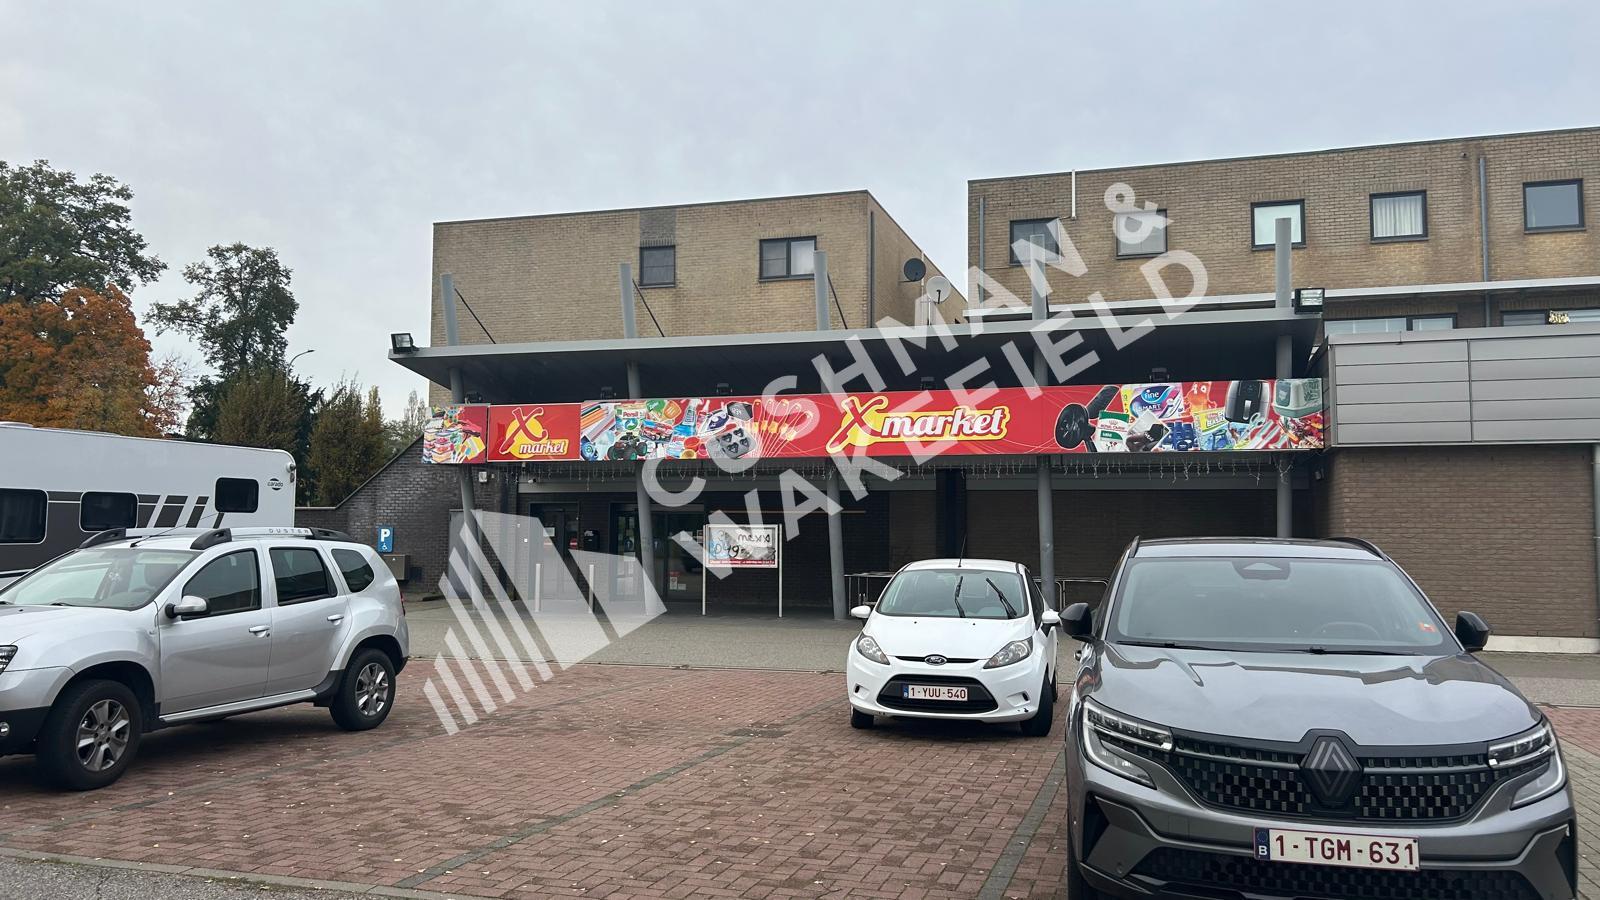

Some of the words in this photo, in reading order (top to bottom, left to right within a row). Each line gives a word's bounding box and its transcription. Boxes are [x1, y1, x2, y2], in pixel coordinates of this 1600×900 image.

[881, 408, 1004, 437] market
[519, 440, 565, 455] market
[380, 528, 391, 542] P
[910, 687, 967, 699] 1-YUU-540
[1258, 845, 1268, 856] B
[1275, 835, 1414, 866] 1-TGM-631
